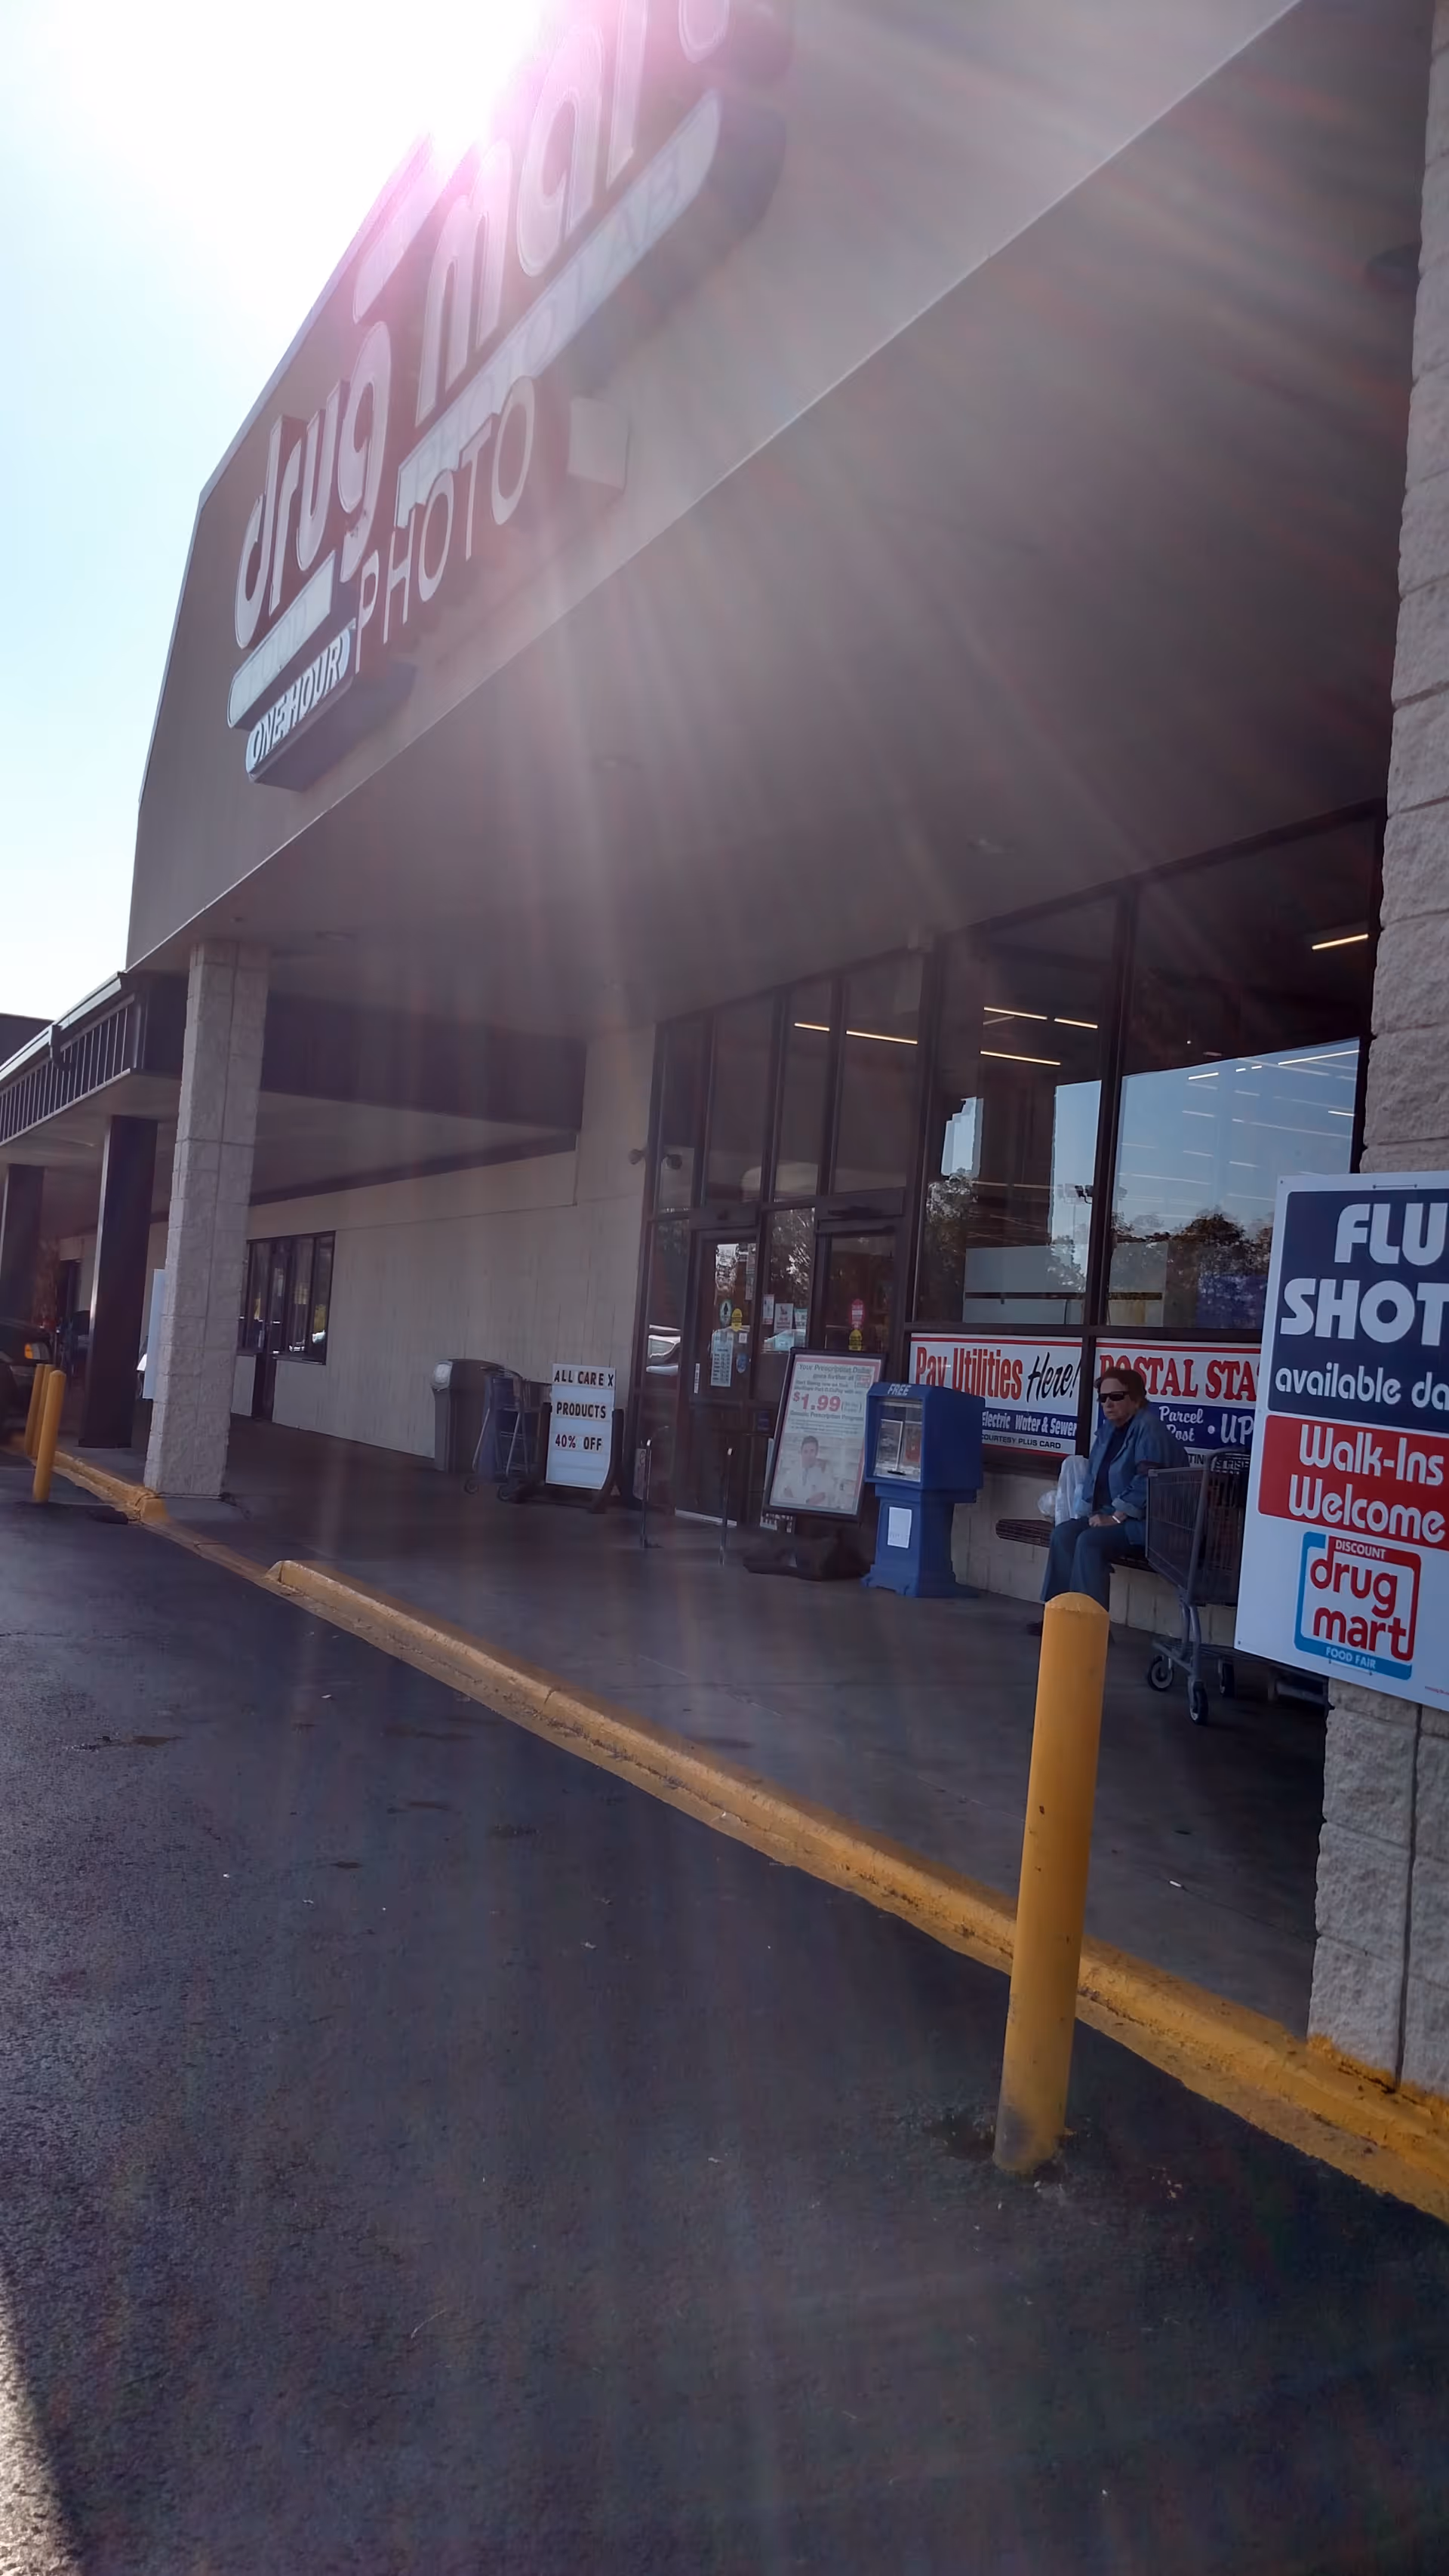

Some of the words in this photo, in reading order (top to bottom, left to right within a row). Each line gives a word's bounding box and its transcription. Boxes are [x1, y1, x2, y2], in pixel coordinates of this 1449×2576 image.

[235, 321, 391, 650] drug
[355, 374, 535, 674] PHOTO
[253, 693, 288, 765] ONE
[291, 636, 343, 730] HOUR
[1334, 1202, 1448, 1266] FLU
[554, 1370, 573, 1383] ALL
[887, 1383, 912, 1396] FREE
[952, 1347, 1023, 1401] Utilities
[1026, 1352, 1082, 1403] Here!
[1204, 1359, 1260, 1402] STA
[1275, 1362, 1401, 1405] available
[556, 1402, 606, 1419] PRODUCTS
[792, 1391, 841, 1411] $1.99
[1159, 1405, 1204, 1424] Parcel
[982, 1411, 1011, 1429] Electric
[1015, 1414, 1041, 1433] Water
[1041, 1416, 1048, 1433] &
[1050, 1417, 1078, 1437] Sewer
[1166, 1424, 1195, 1442] Post
[555, 1433, 576, 1448] 40%
[583, 1436, 602, 1451] OFF
[1018, 1438, 1038, 1447] PLUS
[1039, 1440, 1061, 1449] CARD
[1299, 1423, 1444, 1486] Walk-Ins
[1288, 1474, 1446, 1543] Welcome
[1334, 1540, 1387, 1560] DISCOUNT
[1310, 1547, 1398, 1619] drug
[1312, 1607, 1410, 1661] mart
[1325, 1646, 1353, 1663] FOOD
[1355, 1654, 1377, 1670] FAIR
